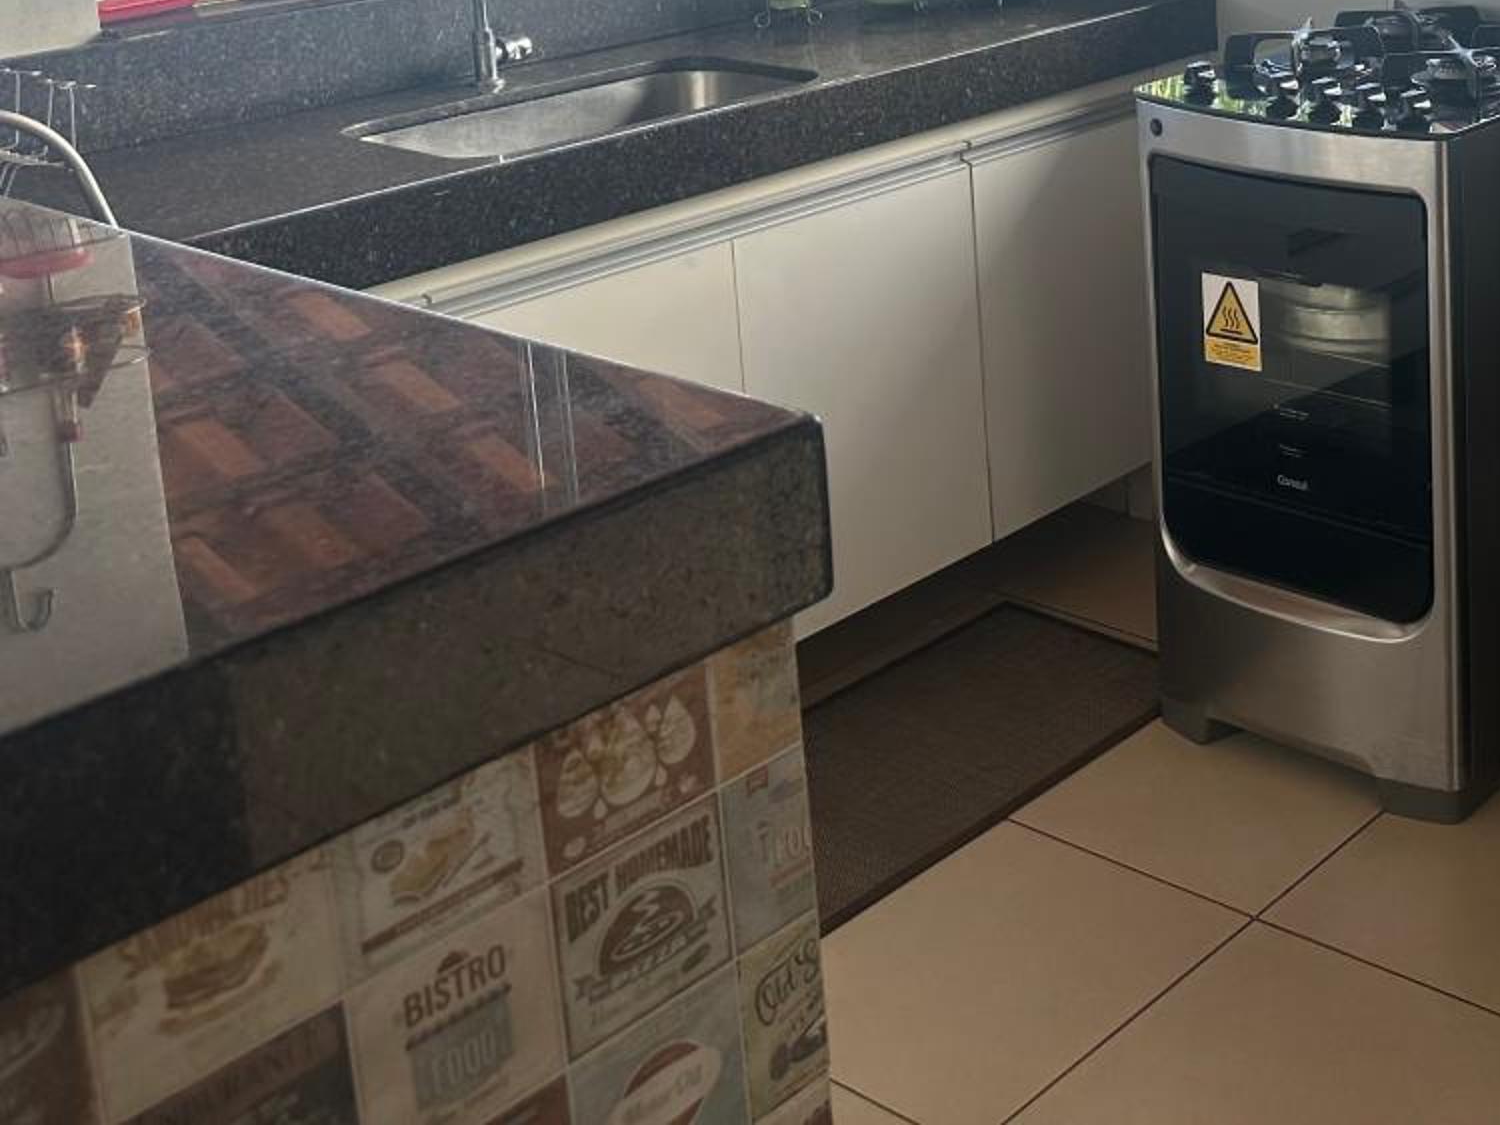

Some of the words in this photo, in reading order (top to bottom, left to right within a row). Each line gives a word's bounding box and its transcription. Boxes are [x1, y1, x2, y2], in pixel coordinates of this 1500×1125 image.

[563, 871, 611, 943] BEST
[613, 813, 714, 897] HOMEMADE
[403, 943, 506, 1028] BISTRO
[431, 1028, 498, 1095] FOOD
